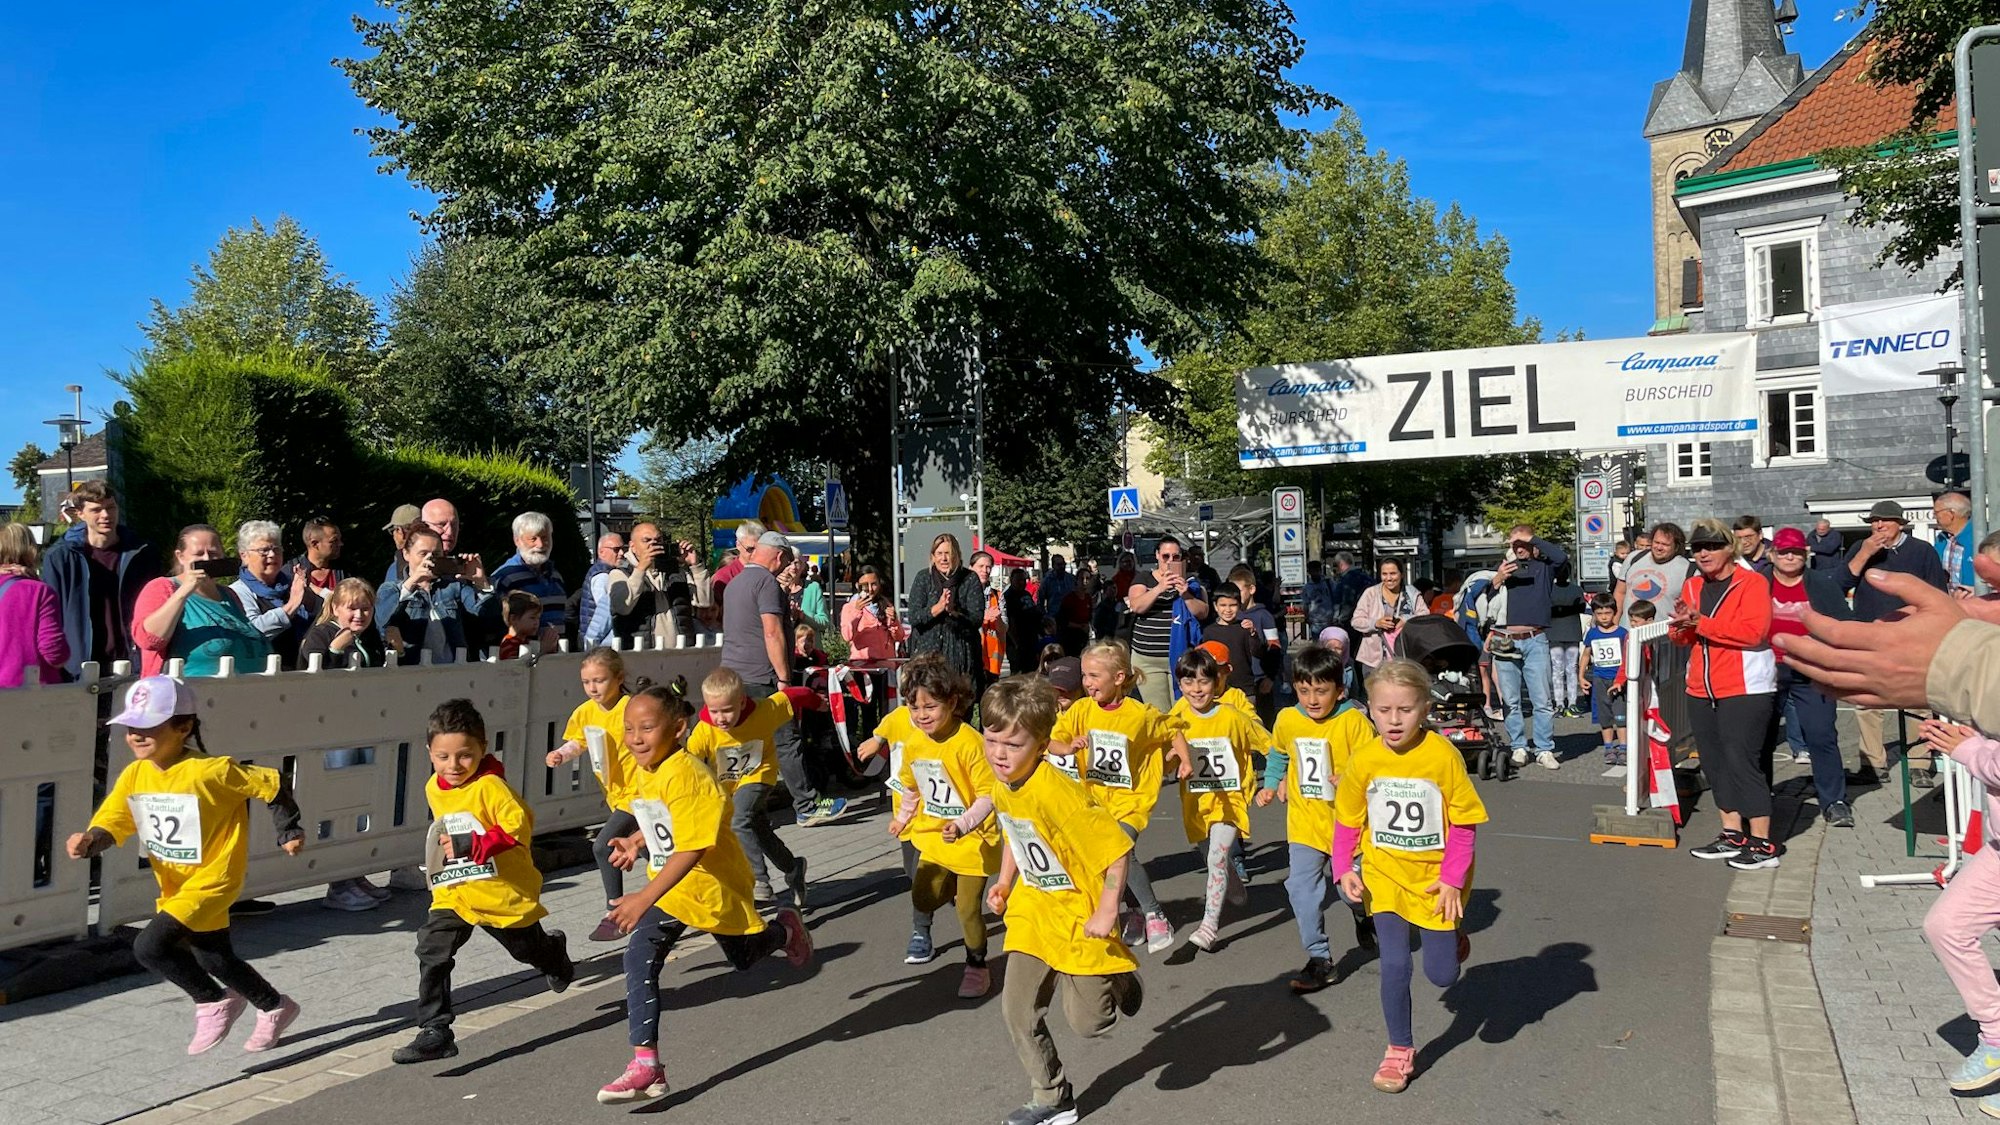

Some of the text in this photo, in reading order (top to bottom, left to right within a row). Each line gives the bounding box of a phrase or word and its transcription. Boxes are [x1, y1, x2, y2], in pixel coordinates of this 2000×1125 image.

[1830, 329, 1950, 359] TENNECO
[1618, 351, 1719, 373] Campana
[1265, 377, 1355, 397] Campana
[1626, 384, 1713, 401] BURSCHEID
[1387, 363, 1576, 442] ZIEL
[1269, 407, 1347, 426] BURSCHEID
[1589, 485, 1599, 495] 20
[1598, 647, 1614, 660] 39
[1095, 747, 1123, 772] 28
[1198, 754, 1226, 778] 25
[929, 777, 951, 803] 27
[1384, 788, 1427, 799] Stadtlauf
[1386, 800, 1424, 833] 29
[149, 814, 182, 845] 32
